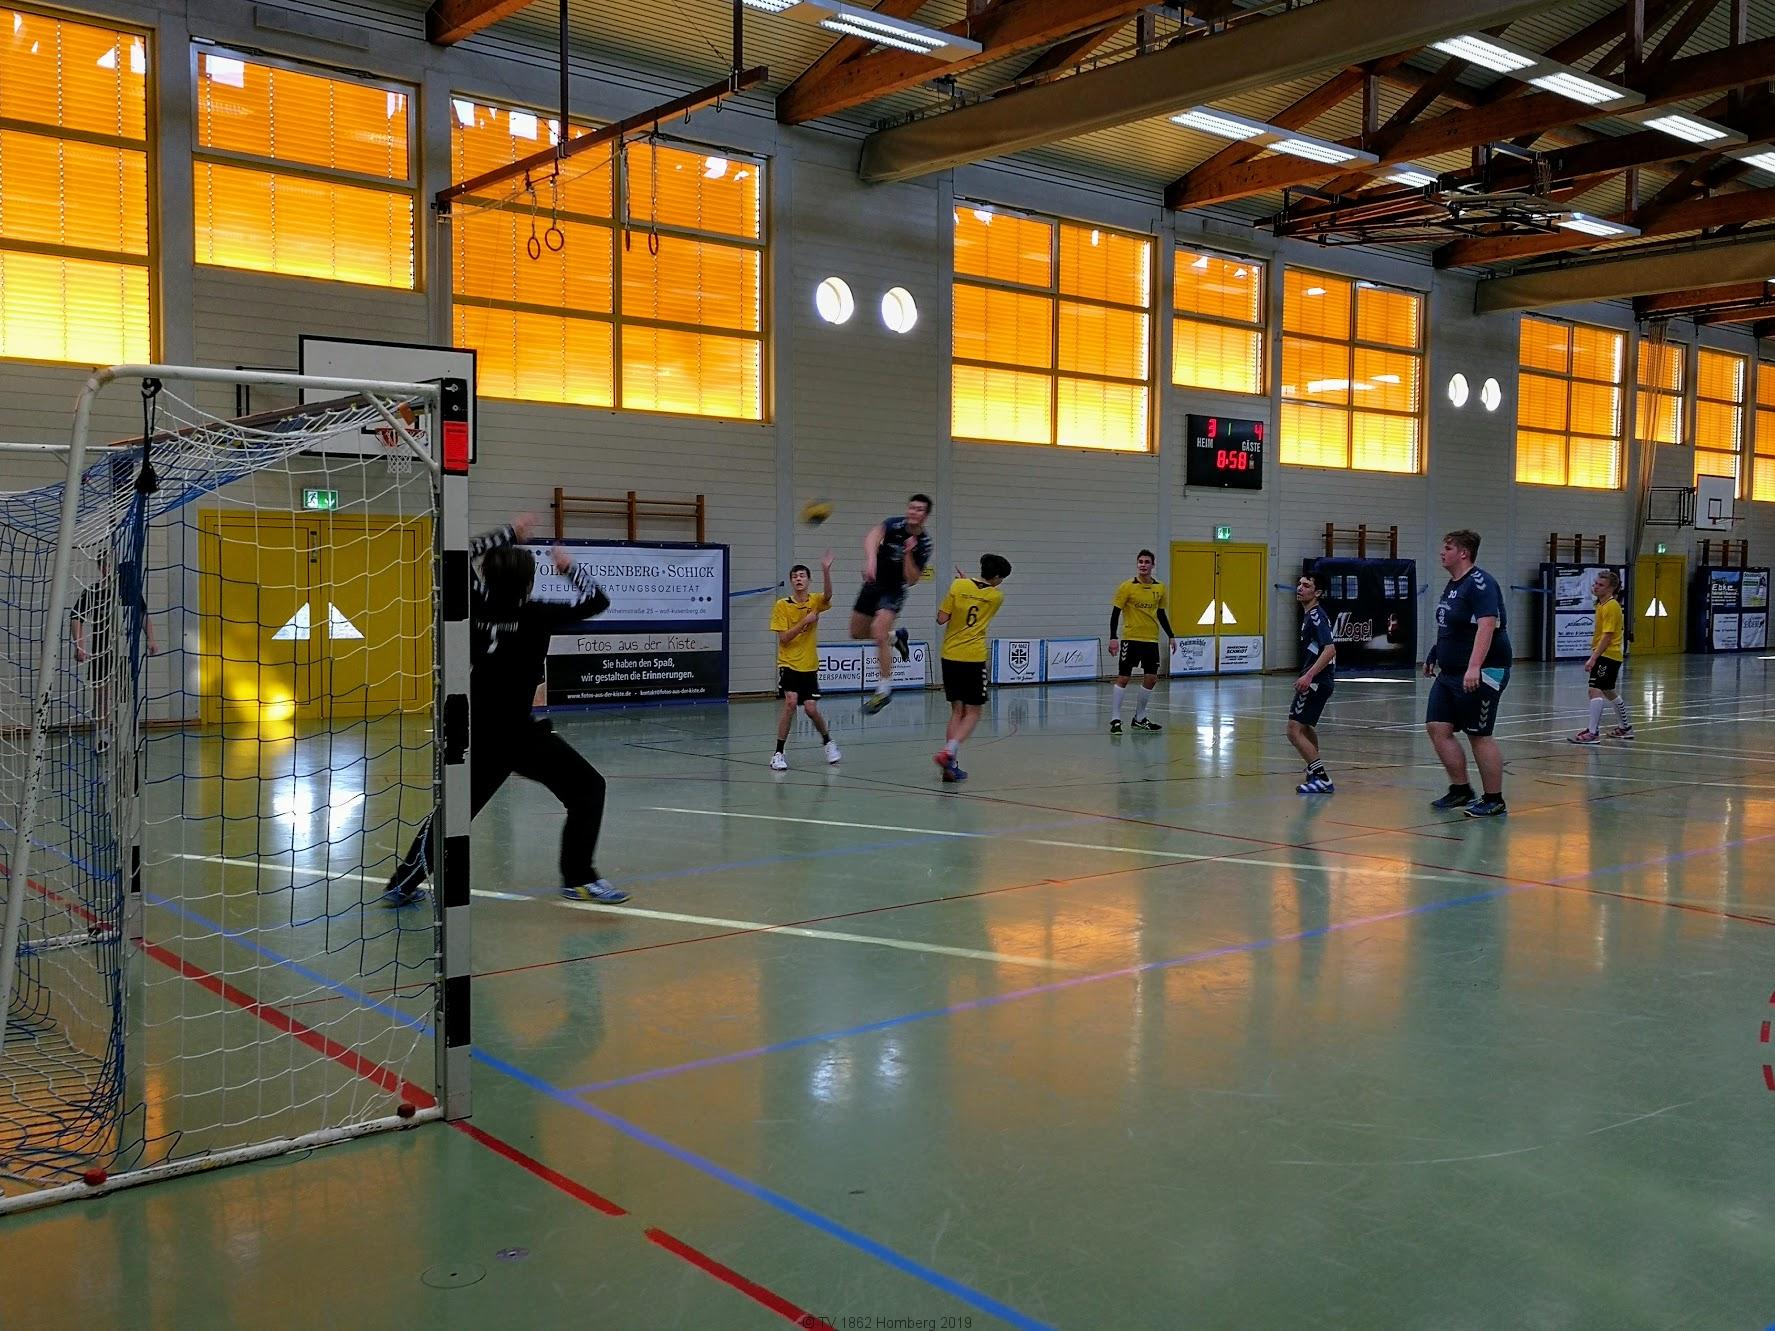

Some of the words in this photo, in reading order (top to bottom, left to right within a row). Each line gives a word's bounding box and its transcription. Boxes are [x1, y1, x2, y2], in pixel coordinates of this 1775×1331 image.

[1208, 418, 1217, 438] 3
[1254, 424, 1263, 441] 4
[1197, 437, 1213, 449] HEIM
[1241, 440, 1261, 453] GÄSTE
[536, 562, 563, 577] OL
[577, 562, 660, 578] KUSENBERG
[667, 565, 715, 578] SCHICK
[966, 605, 979, 627] 6
[577, 637, 612, 652] Fotos
[618, 641, 639, 651] aus
[644, 637, 662, 650] der
[667, 635, 696, 650] Kiste
[602, 659, 614, 669] Sie
[615, 658, 637, 669] haben
[638, 658, 651, 668] den
[653, 658, 675, 668] Spaß,
[581, 673, 593, 683] wir
[595, 671, 629, 684] gestalten
[629, 671, 641, 681] die
[642, 670, 694, 682] Erinnerungen.
